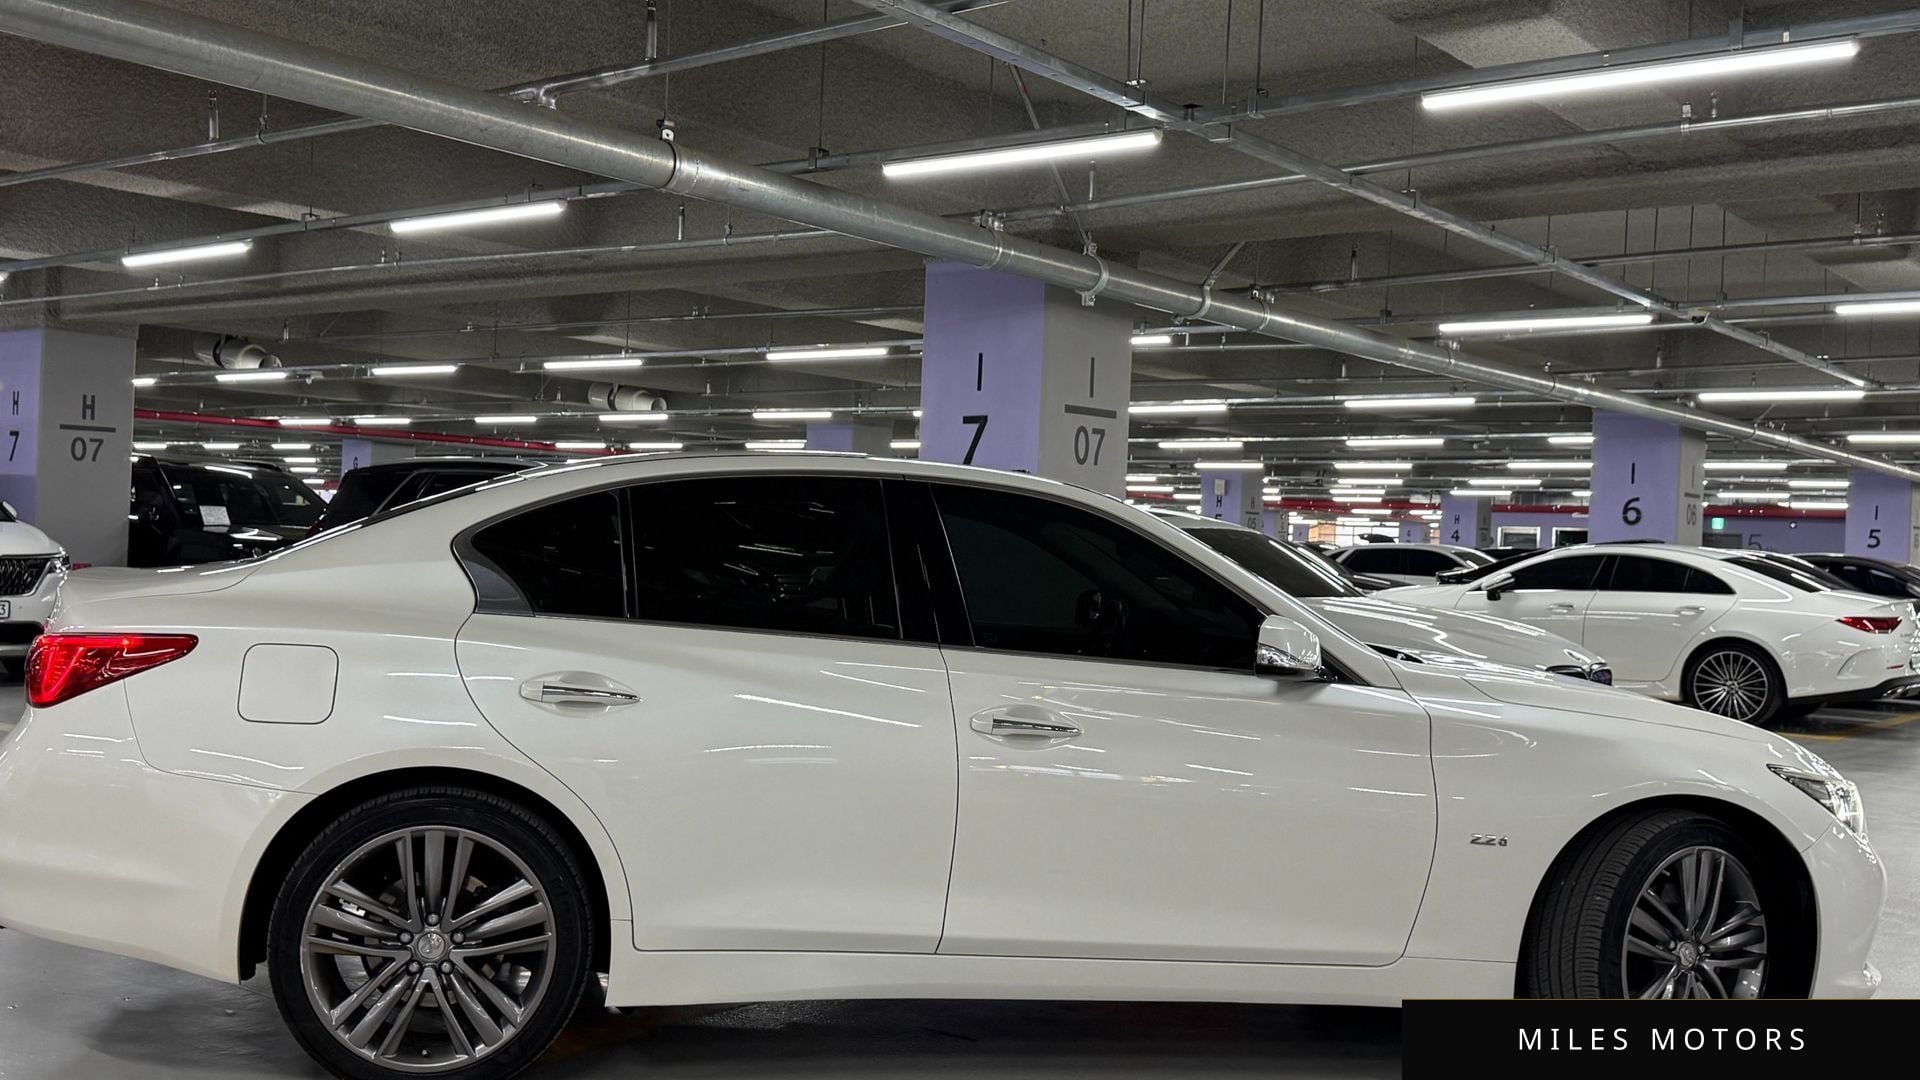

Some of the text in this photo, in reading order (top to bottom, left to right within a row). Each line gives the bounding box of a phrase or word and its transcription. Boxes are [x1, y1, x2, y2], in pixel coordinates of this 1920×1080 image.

[976, 352, 983, 391] I
[12, 391, 20, 416] H
[82, 394, 96, 420] H
[9, 430, 20, 462] 7
[70, 436, 104, 462] 07
[963, 415, 988, 465] 7
[1074, 425, 1106, 466] 07
[1454, 514, 1461, 525] H
[1622, 497, 1642, 526] 6
[1450, 529, 1460, 542] 4
[1867, 529, 1881, 549] 5
